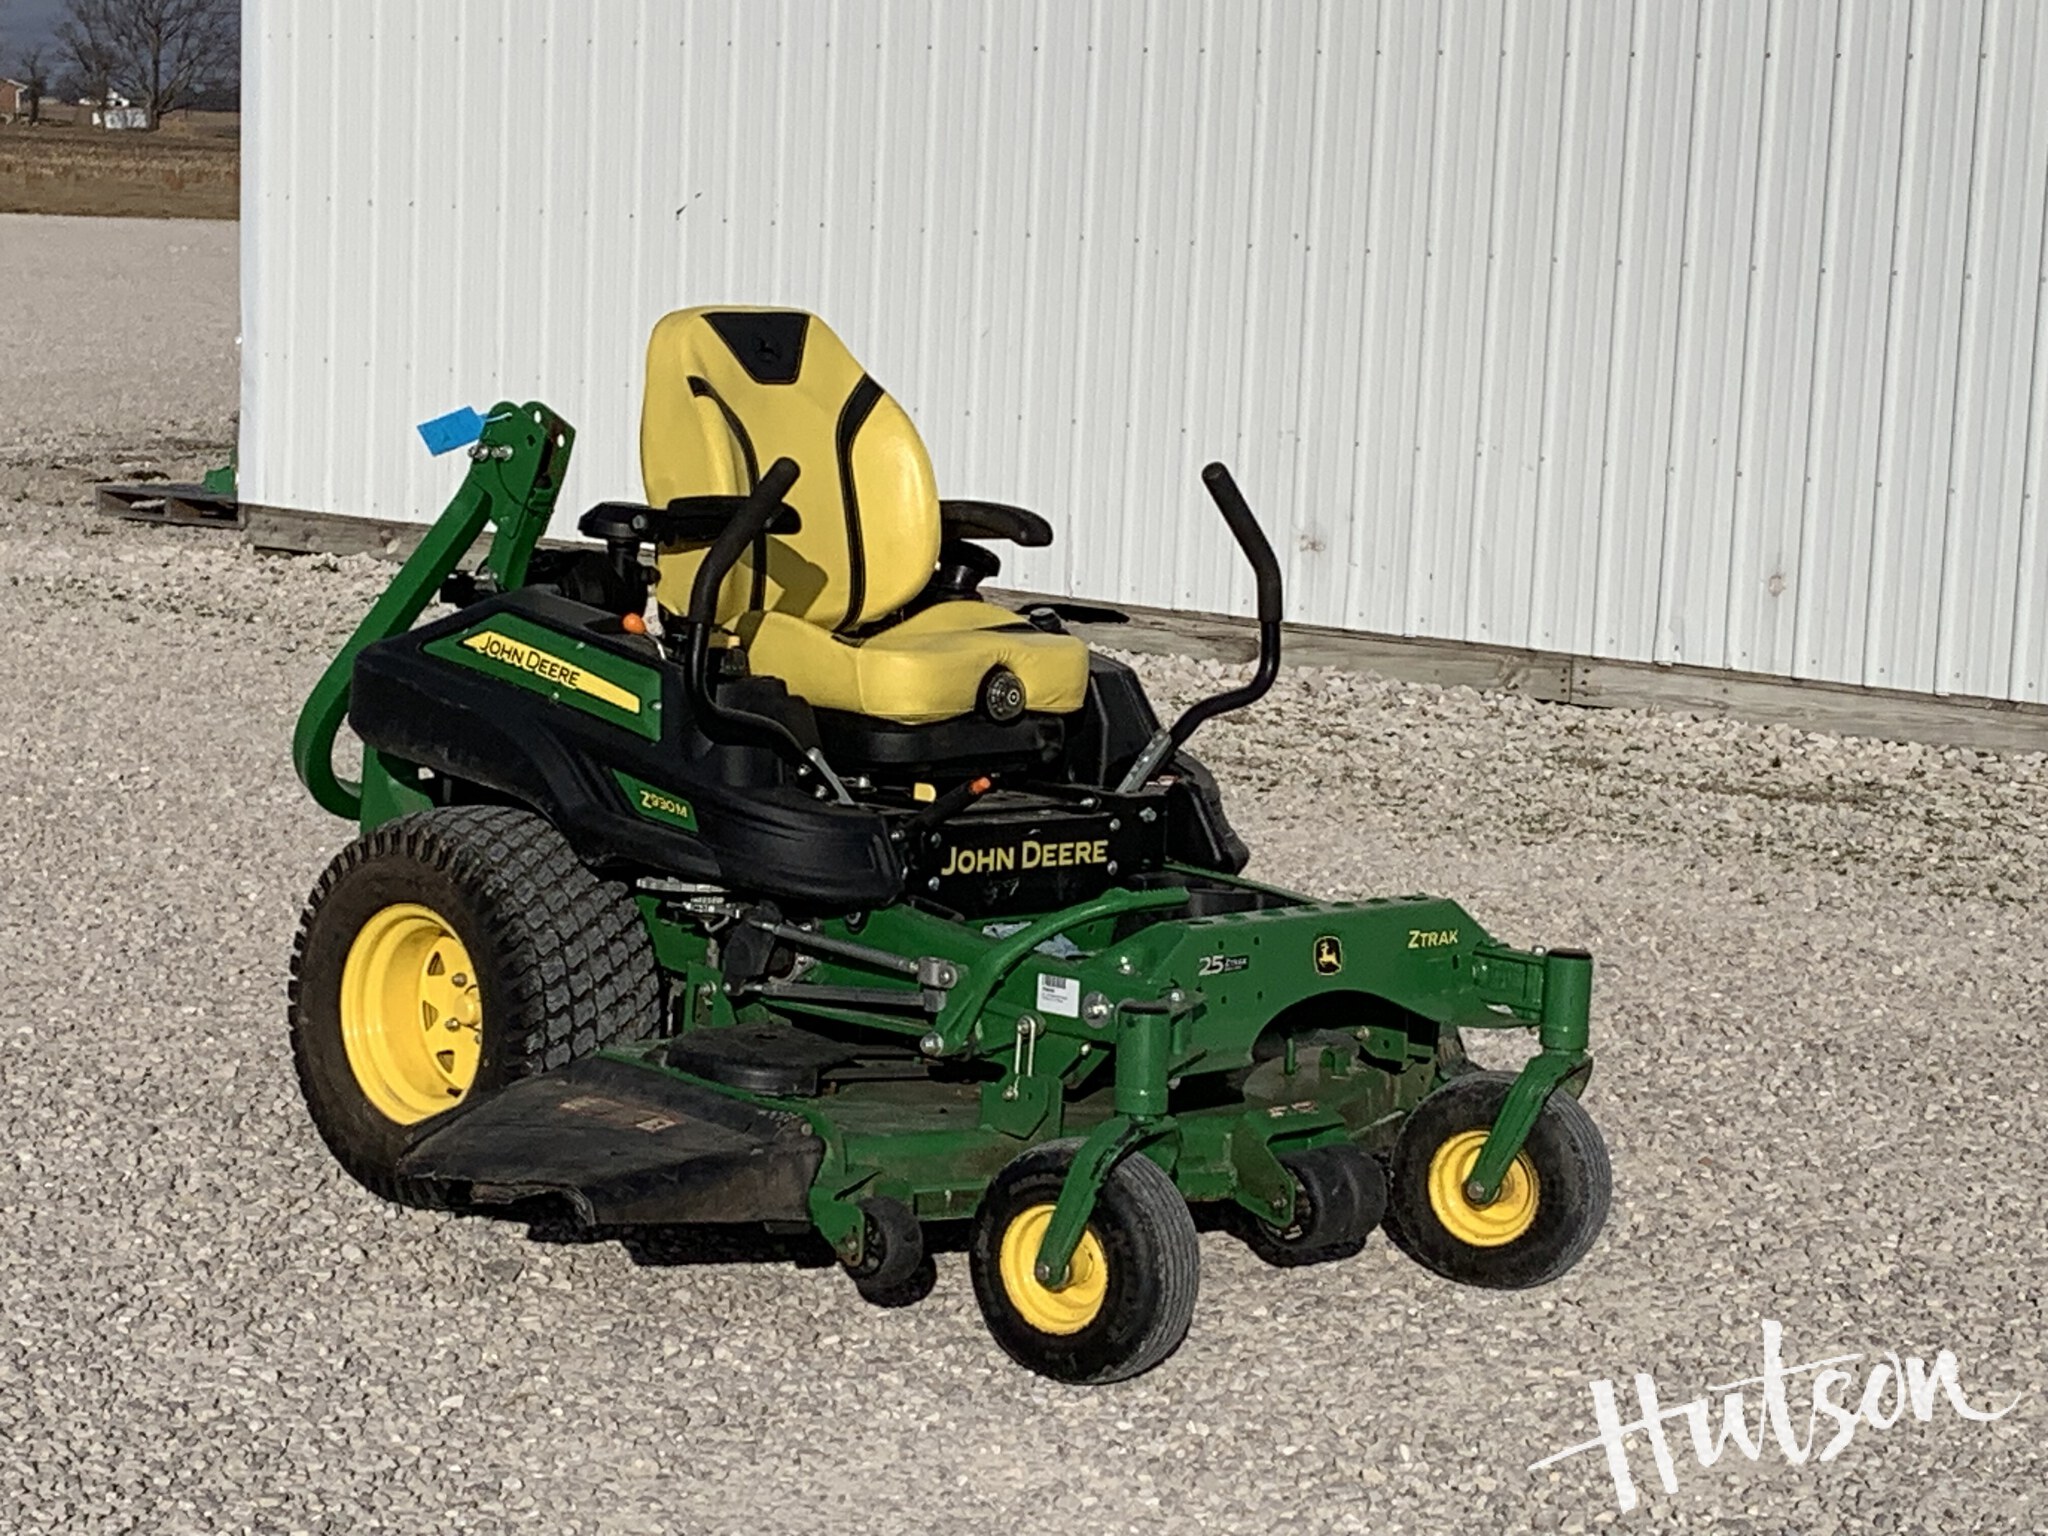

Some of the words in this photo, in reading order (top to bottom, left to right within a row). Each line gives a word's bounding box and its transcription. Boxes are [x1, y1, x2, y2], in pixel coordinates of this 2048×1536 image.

[479, 635, 525, 665] JOHN
[525, 651, 581, 687] DEERE
[941, 846, 1015, 876] JOHN
[1021, 839, 1109, 869] DEERE
[1407, 929, 1459, 949] ZTRAK
[1198, 955, 1225, 976] 25
